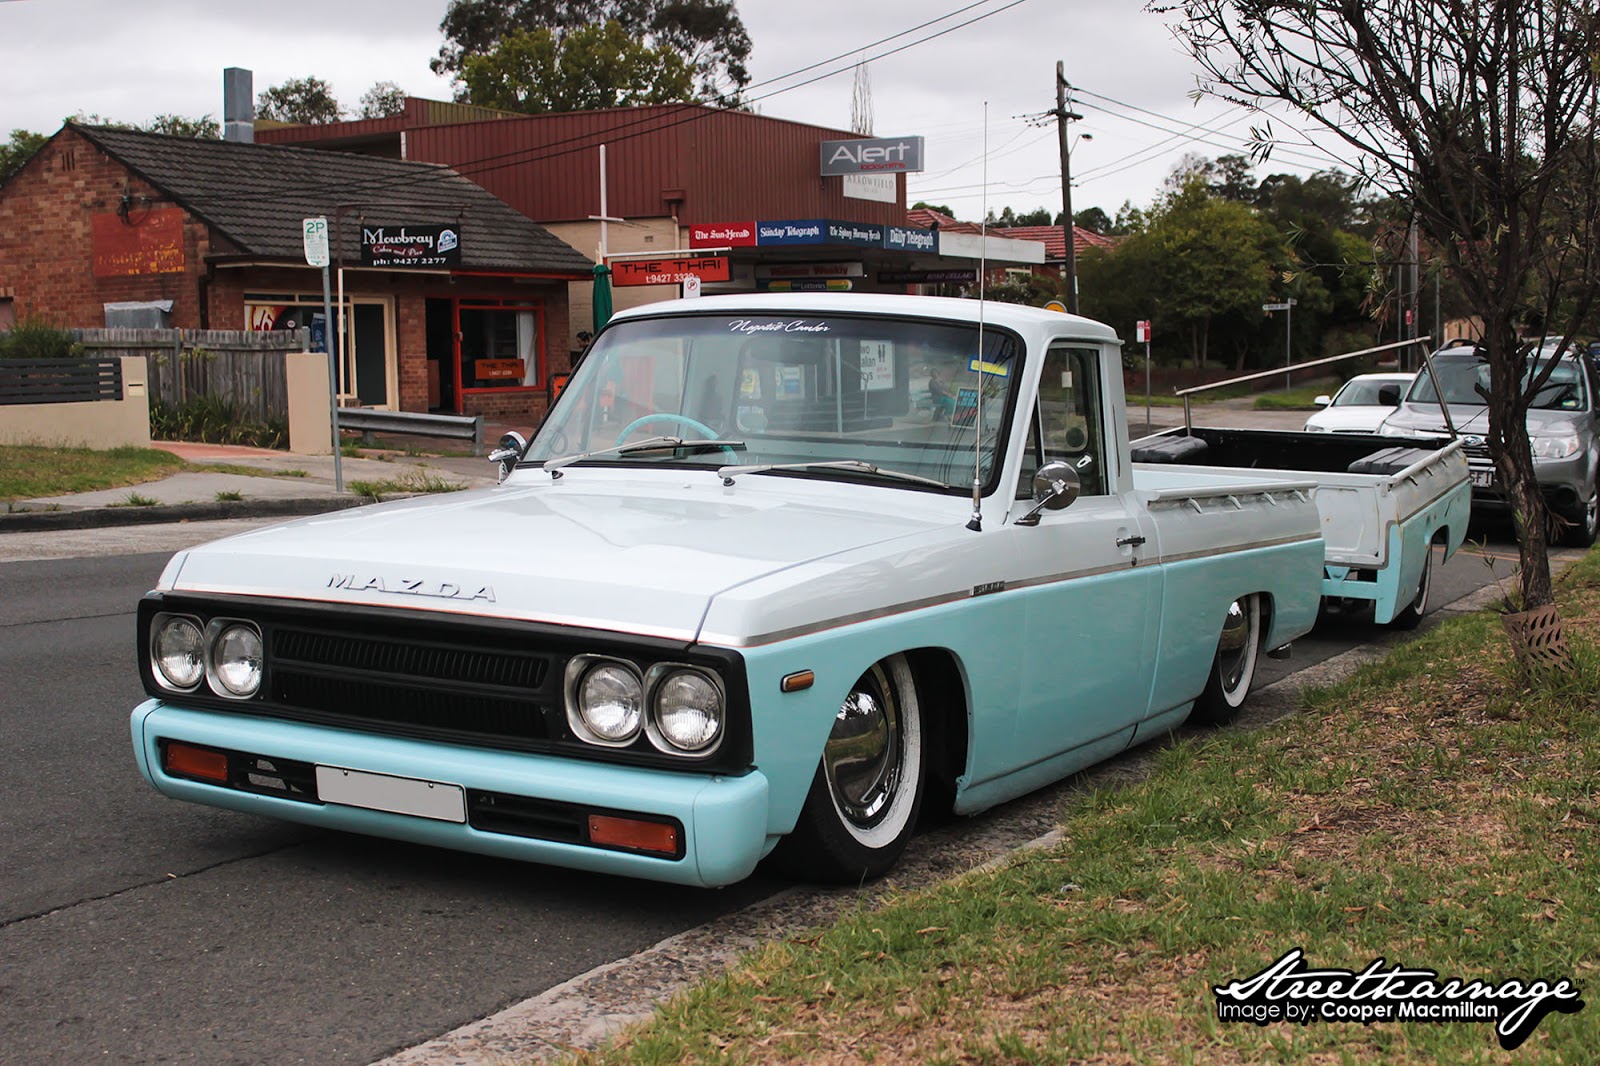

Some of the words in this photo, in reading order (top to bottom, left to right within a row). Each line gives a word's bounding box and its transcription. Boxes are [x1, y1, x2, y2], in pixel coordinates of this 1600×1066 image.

[828, 142, 911, 165] Alert
[306, 222, 325, 234] 2P
[694, 230, 709, 240] The
[760, 226, 785, 239] Sunday
[785, 225, 820, 238] Telegraph
[829, 225, 838, 236] The
[838, 226, 852, 240] Sydney
[362, 227, 434, 249] Mowbray
[889, 228, 906, 247] Daily
[906, 230, 934, 249] Telegraph
[372, 257, 390, 266] ph:
[393, 257, 418, 265] 9427
[421, 257, 447, 265] 2277
[620, 262, 662, 274] THE
[673, 259, 721, 271] THAI
[326, 573, 497, 603] MAZDA
